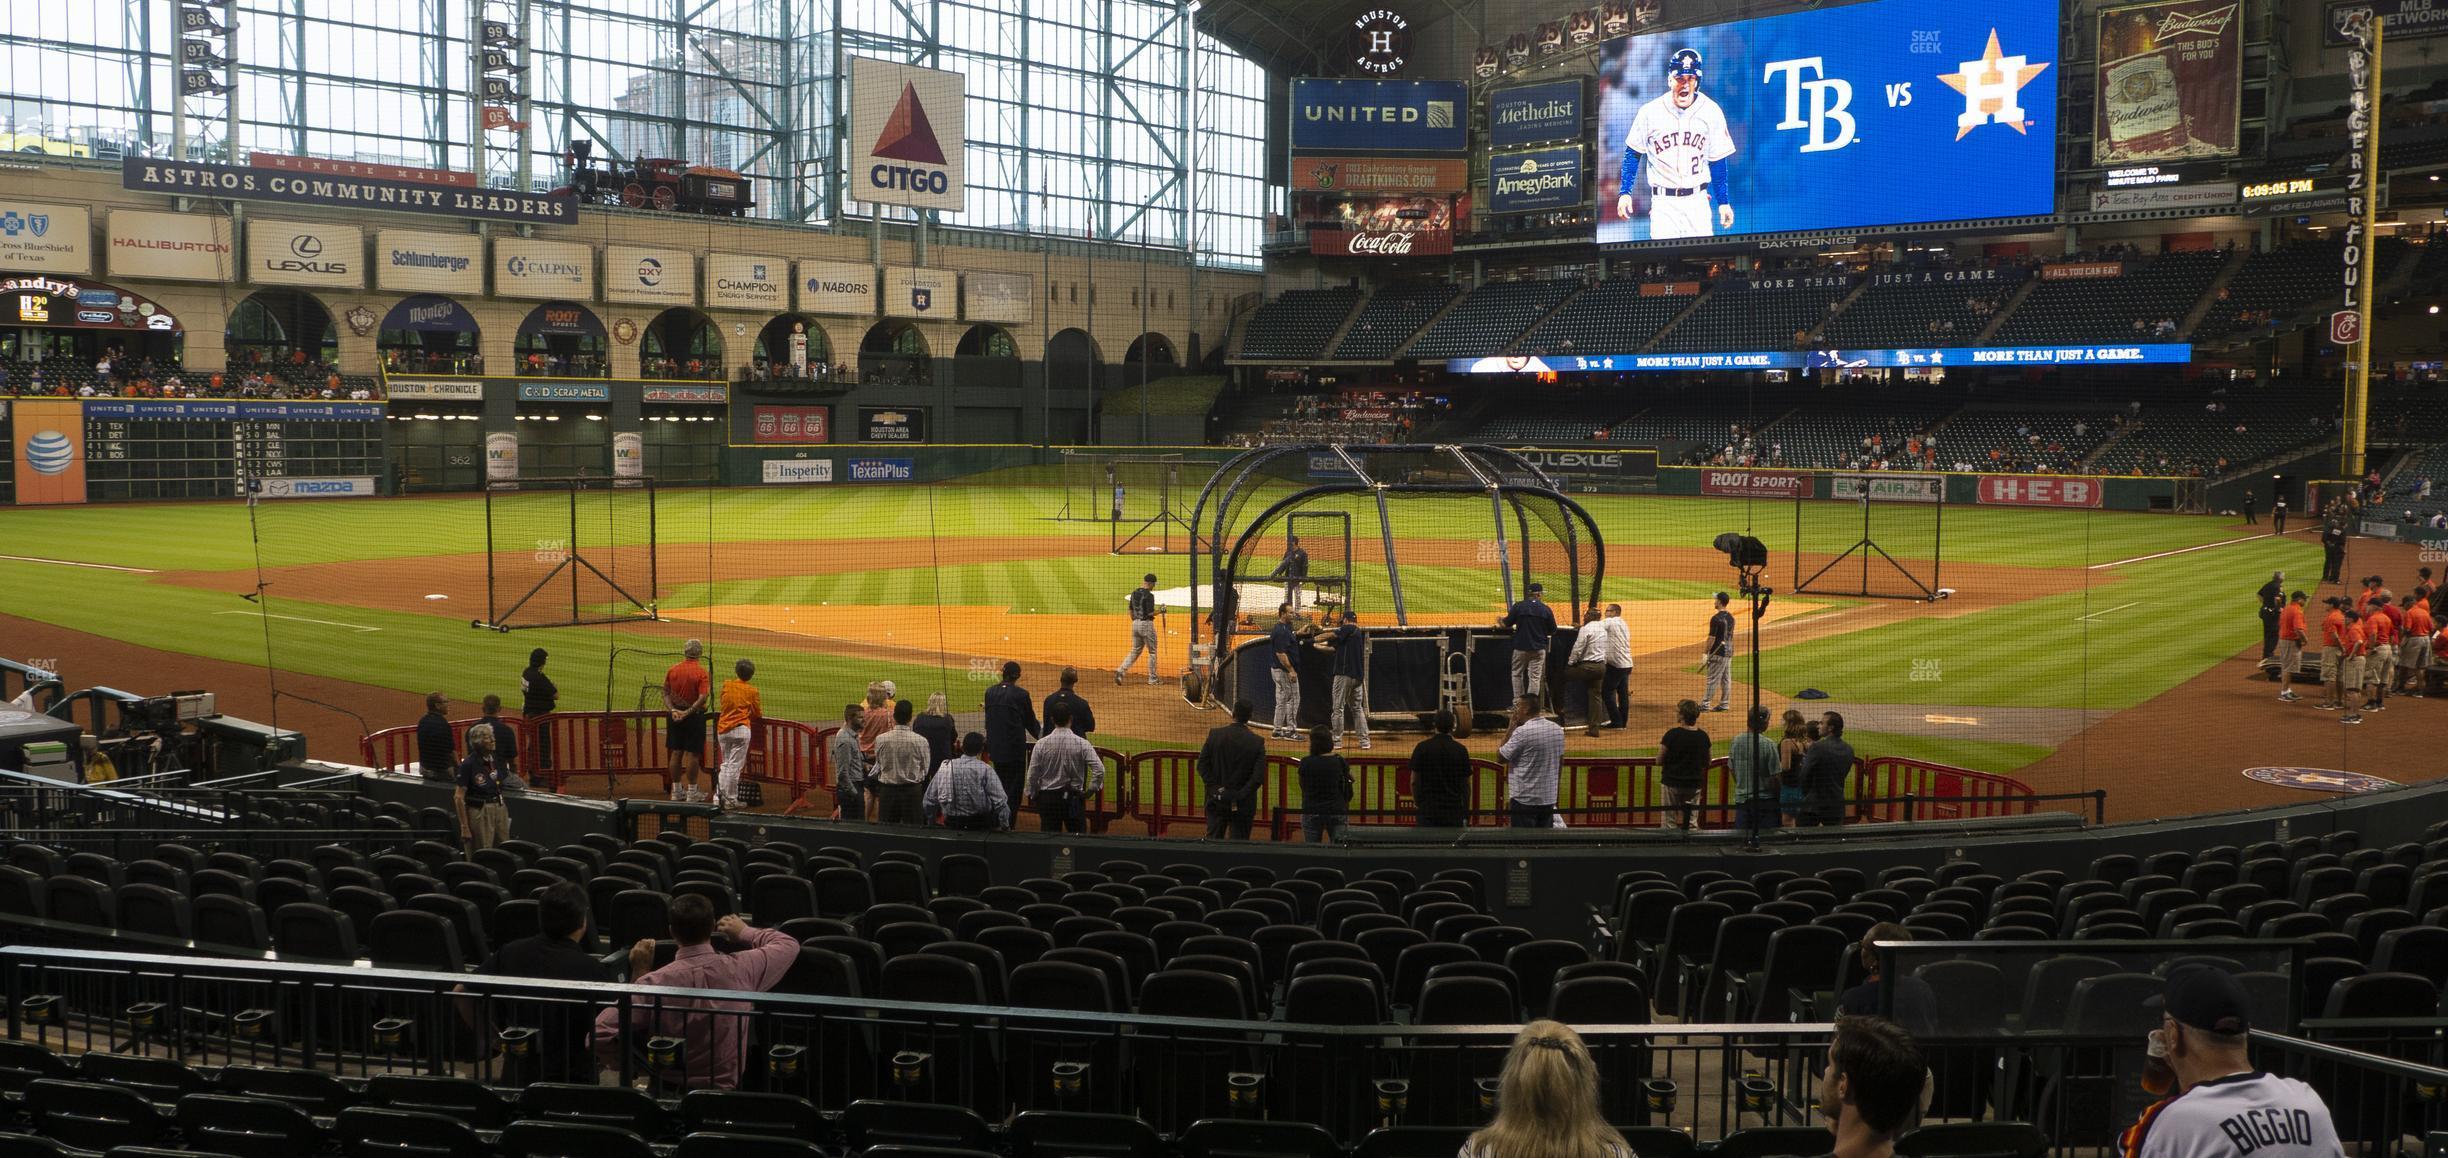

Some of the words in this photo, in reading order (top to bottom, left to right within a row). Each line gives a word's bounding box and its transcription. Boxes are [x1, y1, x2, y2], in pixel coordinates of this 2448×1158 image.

[2400, 0, 2432, 12] MLB
[187, 13, 205, 25] 86
[1356, 10, 1406, 30] HOUSTON
[2157, 15, 2232, 32] Budweiser
[487, 26, 503, 38] 99
[1370, 31, 1392, 53] H
[2177, 42, 2194, 50] THIS
[2197, 38, 2220, 48] BUD'S
[188, 44, 205, 56] 97
[2182, 52, 2197, 62] FOR
[2199, 50, 2214, 60] YOU
[488, 55, 503, 66] 01
[1357, 56, 1404, 72] ASTROS
[188, 75, 207, 87] 98
[489, 83, 504, 94] 04
[1496, 100, 1526, 108] HOUSTON
[1763, 56, 1856, 153] TB
[488, 112, 504, 122] 05
[1305, 106, 1418, 122] UNITED
[1496, 100, 1574, 124] Methodist
[1654, 131, 1707, 154] ASTROS
[276, 158, 374, 174] MINUTE
[398, 170, 456, 182] MAID
[2108, 168, 2146, 178] WELCOME
[2147, 167, 2159, 175] TO
[870, 164, 948, 194] CITGO
[1346, 174, 1436, 188] DRAFTKINGS.COM
[1496, 173, 1574, 196] AmegyBank
[2108, 176, 2136, 186] MINUTE
[143, 166, 254, 190] ASTROS
[270, 178, 443, 206] COMMUNITY
[455, 194, 564, 216] LEADERS
[2242, 182, 2288, 198] 6:09:05
[2290, 180, 2313, 193] PM
[2204, 192, 2233, 200] UNION
[2270, 204, 2291, 212] HOME
[2292, 202, 2312, 210] FIELD
[24, 242, 74, 253] BlueShield
[113, 238, 229, 254] HALLIBURTON
[1760, 236, 1856, 249] DAKTRONICS
[4, 252, 16, 262] of
[16, 253, 45, 262] Texas
[392, 250, 470, 272] Schlumberger
[266, 259, 347, 274] LEXUS
[528, 262, 582, 276] CALPINE
[638, 268, 662, 276] OXY
[2053, 268, 2067, 276] ALL
[2069, 268, 2083, 276] YOU
[2103, 266, 2119, 274] EAT
[2344, 224, 2362, 307] FOUL
[718, 278, 777, 292] CHAMPION
[1752, 280, 1794, 289] MORE
[1804, 276, 1847, 287] THAN
[1874, 273, 1912, 286] JUST
[1924, 272, 1932, 282] A
[822, 282, 868, 294] NABORS
[410, 302, 453, 324] Montejo
[545, 310, 580, 322] ROOT
[1637, 357, 1670, 367] MORE
[1672, 356, 1700, 366] THAN
[1701, 356, 1723, 368] JUST
[1724, 356, 1733, 366] A
[1734, 355, 1770, 366] GAME.
[1973, 351, 2014, 362] MORE
[2016, 350, 2052, 361] THAN
[2054, 350, 2084, 362] JUST
[2084, 350, 2095, 360] A
[2096, 349, 2144, 360] GAME.
[434, 384, 478, 394] CHRONICLE
[554, 388, 578, 397] SCRAP
[581, 388, 605, 398] METAL
[1344, 408, 1390, 420] Budweiser
[450, 456, 470, 465] 362
[1546, 453, 1622, 467] LEXUS
[780, 464, 830, 479] Insperity
[851, 464, 910, 478] TexanPlus
[1710, 472, 1750, 487] ROOT
[294, 482, 353, 493] mazda
[2219, 1108, 2312, 1156] BIGGIO
